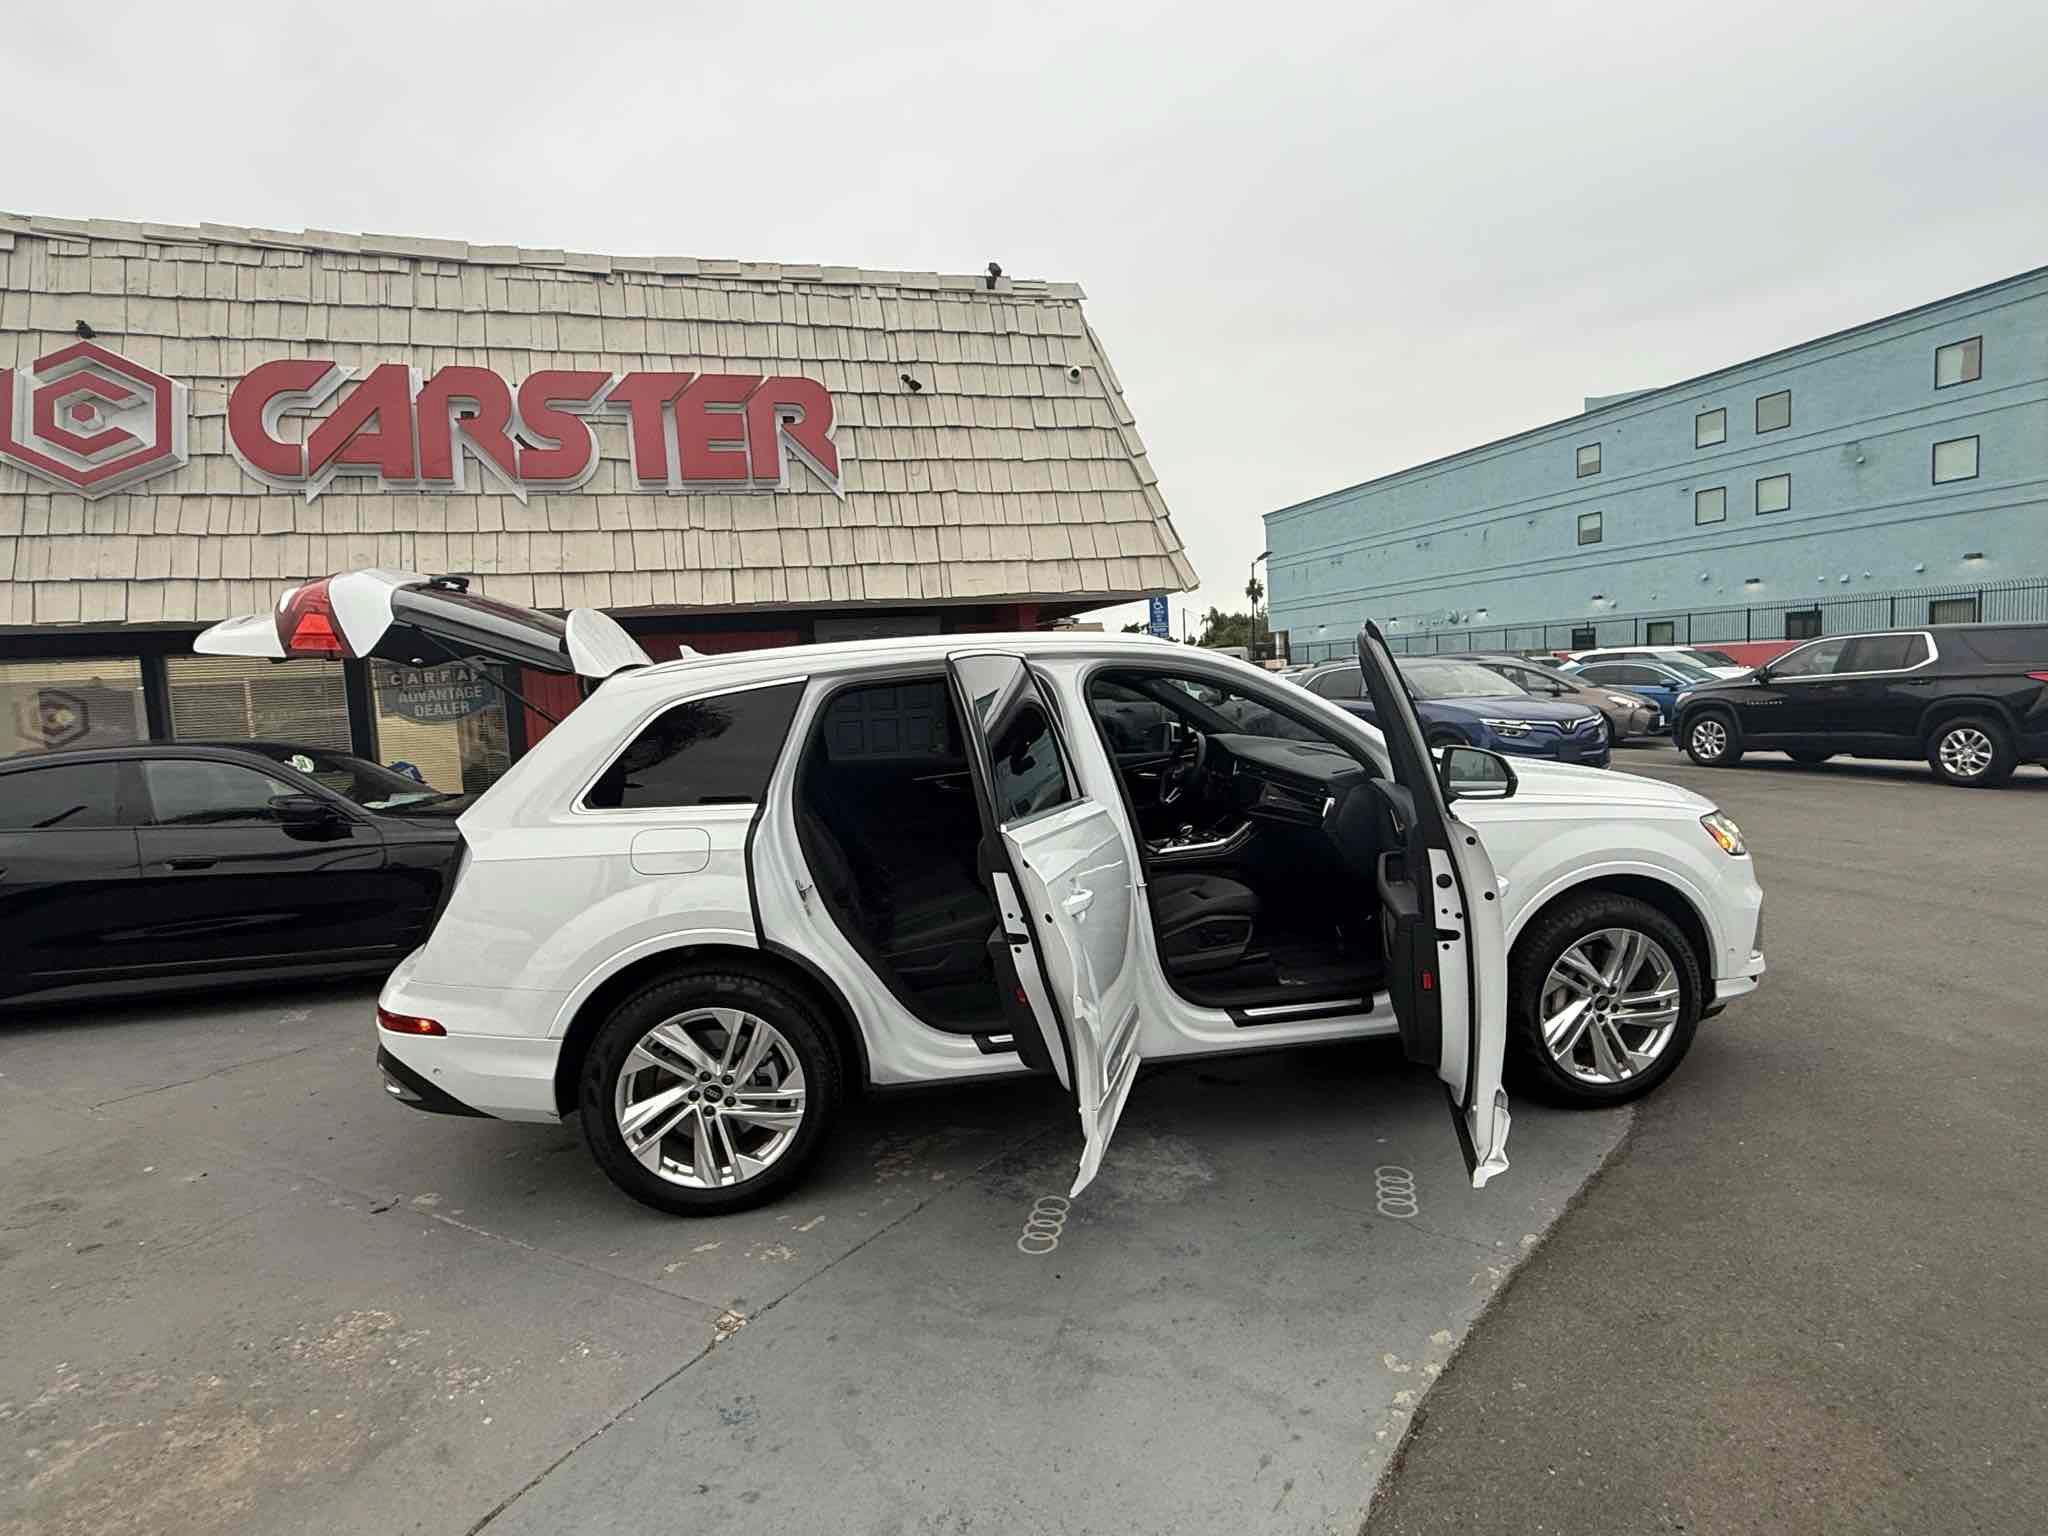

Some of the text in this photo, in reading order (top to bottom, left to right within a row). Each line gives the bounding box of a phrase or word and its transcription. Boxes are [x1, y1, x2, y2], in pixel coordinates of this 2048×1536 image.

[229, 360, 842, 498] CARSTER
[398, 686, 483, 703] ADVANTAGE
[414, 701, 471, 717] DEALER
